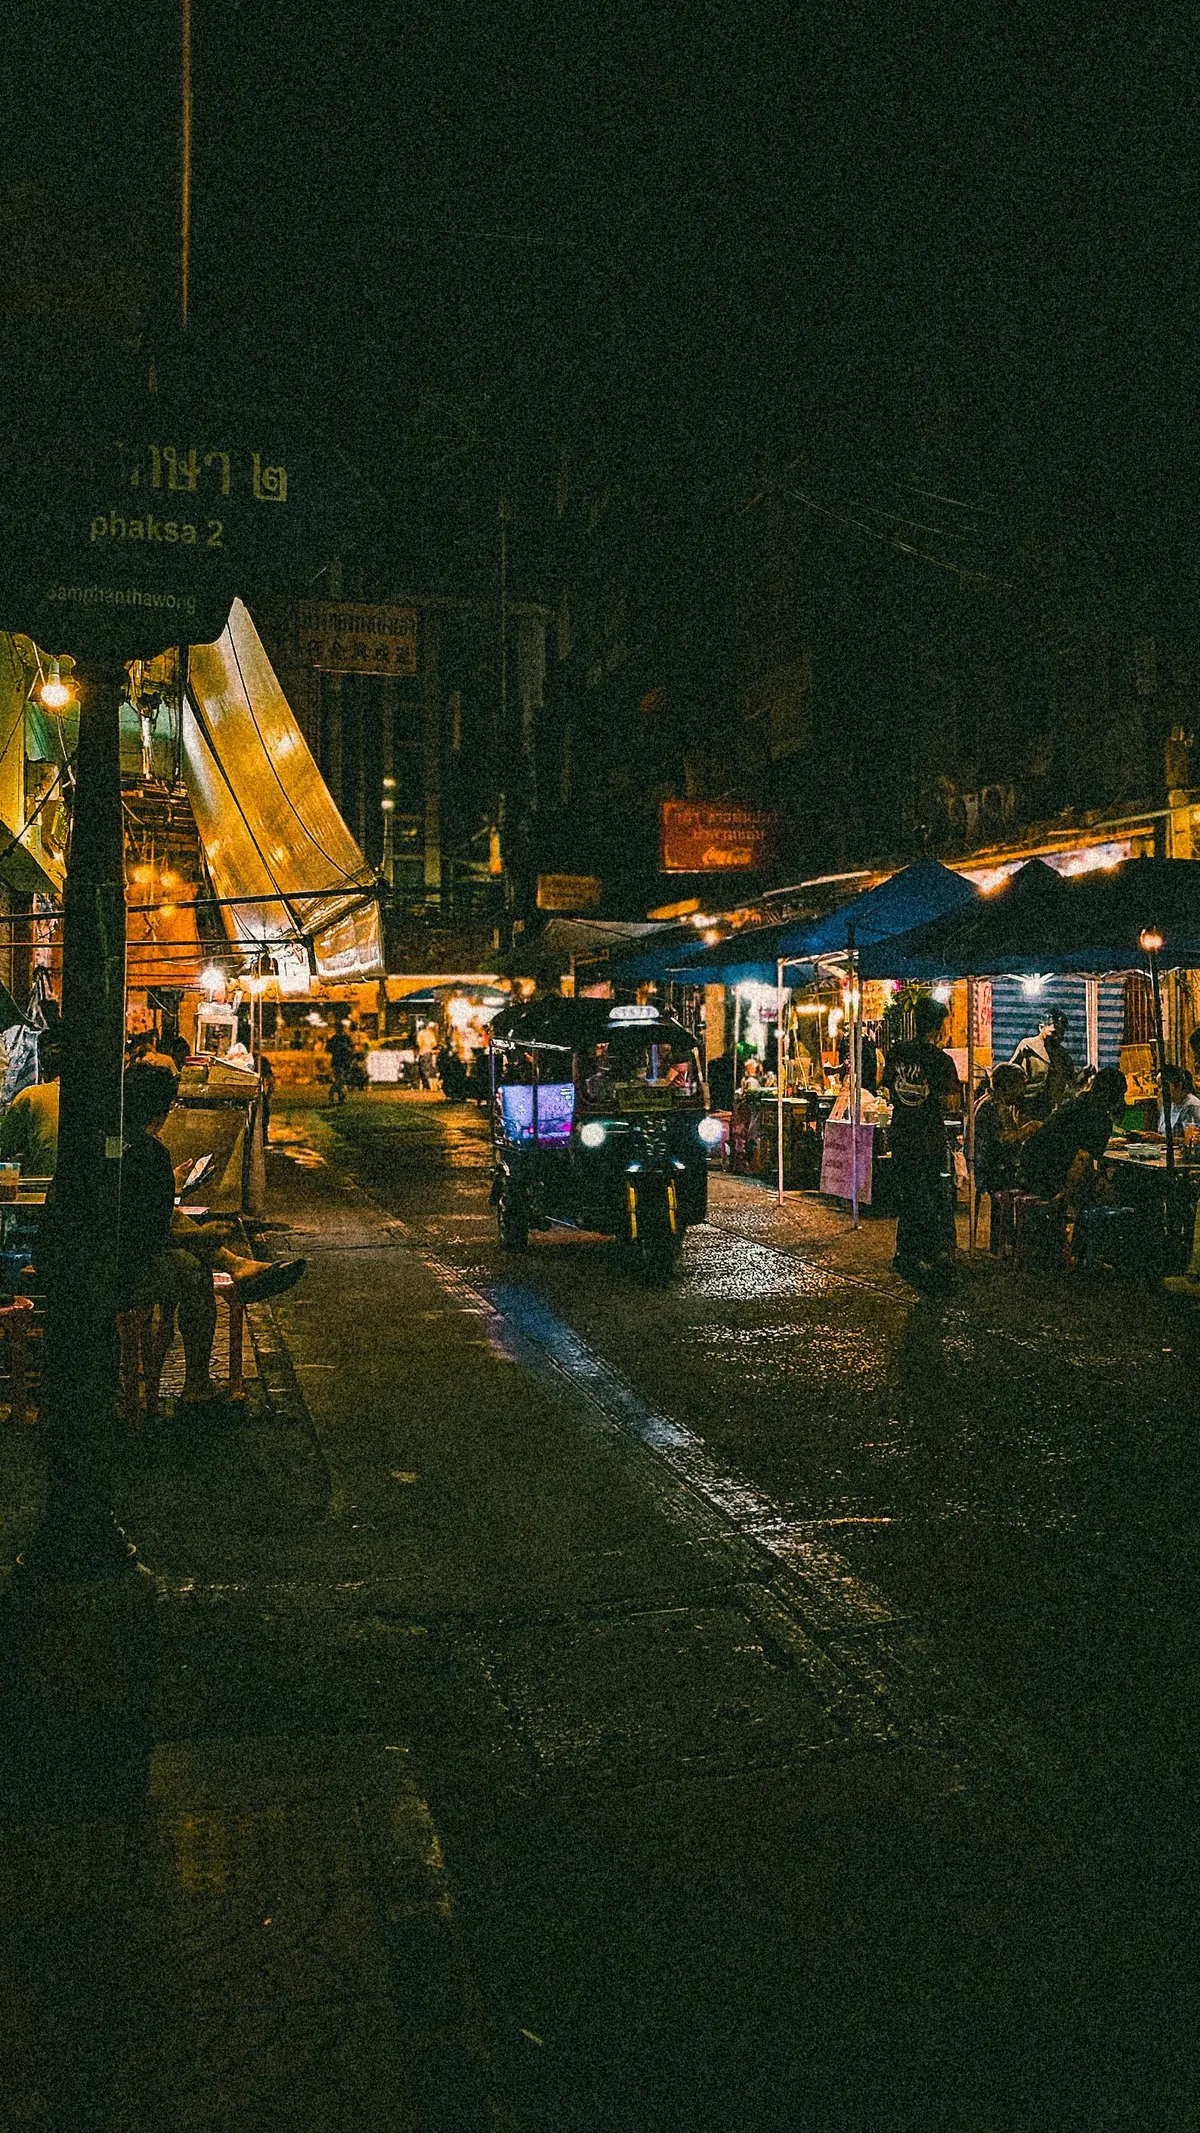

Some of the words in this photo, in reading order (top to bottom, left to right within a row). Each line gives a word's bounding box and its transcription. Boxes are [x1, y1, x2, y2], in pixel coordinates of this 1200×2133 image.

[115, 440, 232, 496] กษา
[251, 451, 289, 504] ๒
[89, 508, 199, 546] phaksa
[205, 519, 225, 549] 2
